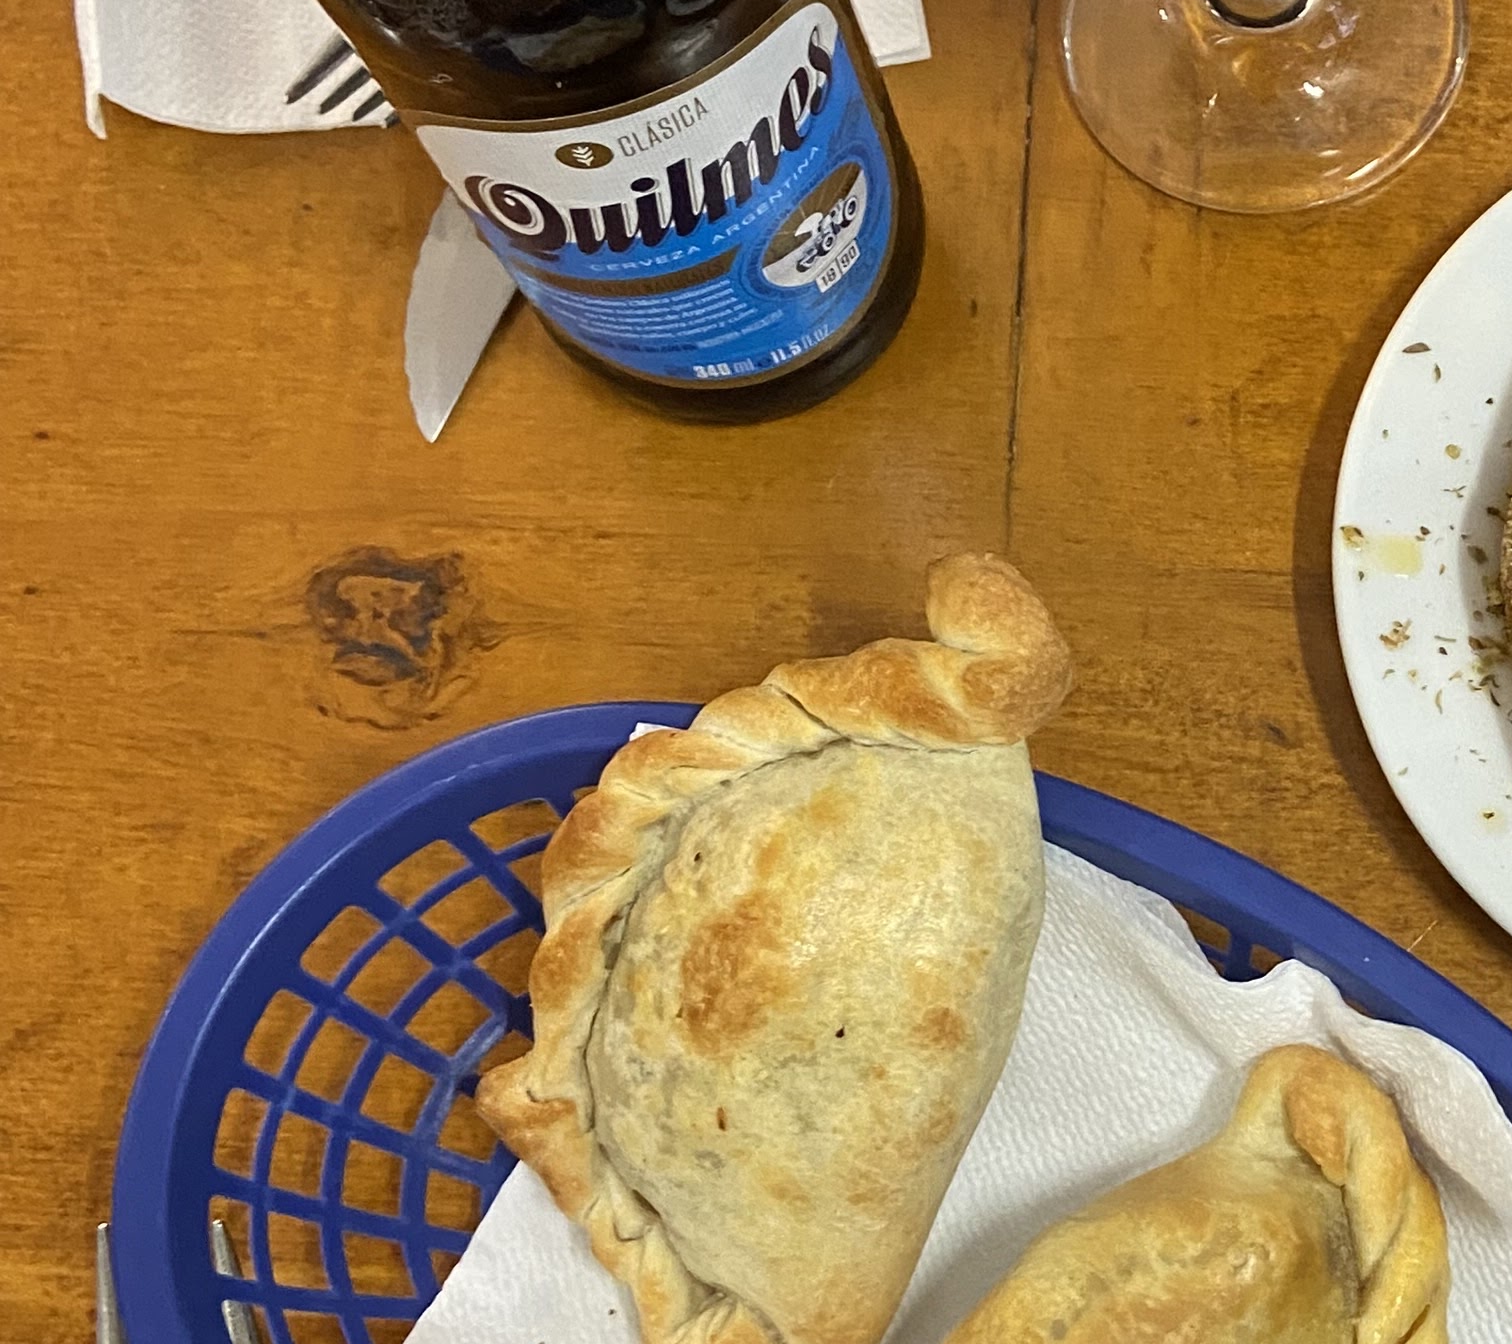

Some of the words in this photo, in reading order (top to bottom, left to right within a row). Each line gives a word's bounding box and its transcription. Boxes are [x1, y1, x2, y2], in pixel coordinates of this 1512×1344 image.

[464, 25, 834, 261] Quilmes
[617, 96, 709, 157] CLÁSICA
[589, 245, 700, 272] CERVEZA
[711, 146, 819, 245] ARGENTINA
